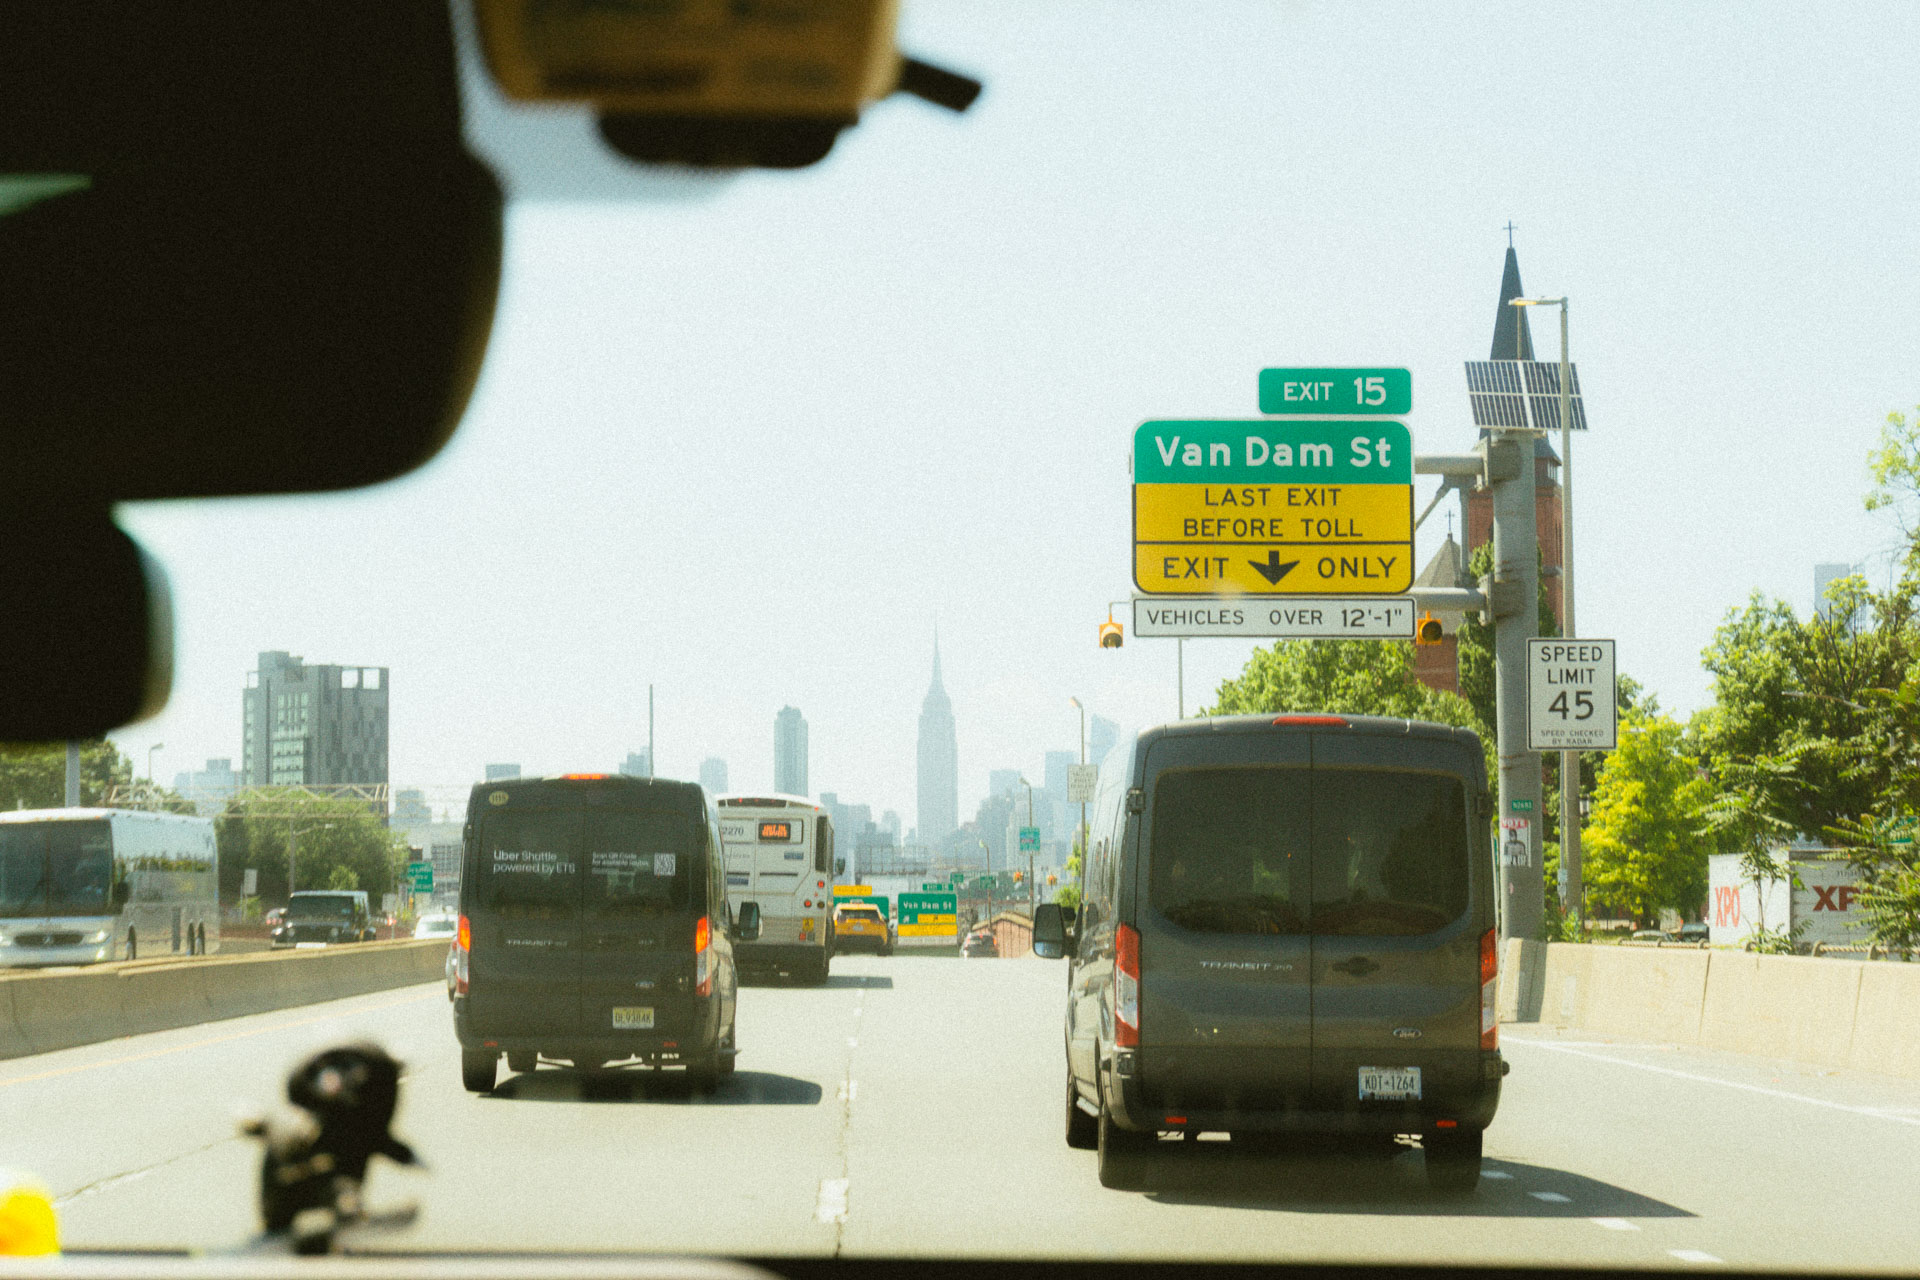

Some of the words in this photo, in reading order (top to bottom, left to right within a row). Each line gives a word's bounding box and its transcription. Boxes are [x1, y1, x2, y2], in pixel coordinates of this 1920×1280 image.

[1283, 381, 1334, 402] EXIT
[1353, 376, 1387, 406] 15
[1155, 435, 1231, 467] Van
[1245, 436, 1334, 468] Dam
[1350, 436, 1391, 468] St
[1204, 487, 1271, 507] LAST
[1287, 487, 1342, 507] EXIT
[1183, 518, 1284, 538] BEFORE
[1300, 518, 1363, 538] TOLL
[1163, 556, 1229, 579] EXIT
[1317, 556, 1396, 579] ONLY
[1147, 609, 1245, 627] VEHICLES
[1269, 609, 1323, 627] OVER
[1341, 608, 1403, 629] 12'-1"
[1541, 646, 1603, 662] SPEED
[1547, 668, 1595, 684] LIMIT
[1548, 690, 1594, 720] 45
[1541, 729, 1565, 737] SPEED
[1569, 729, 1604, 737] CHECKED
[493, 850, 520, 861] Uber
[522, 850, 557, 861] Shuttle
[493, 862, 540, 875] powered
[541, 862, 554, 875] by
[903, 900, 918, 909] Van
[921, 901, 939, 910] Dam
[942, 901, 951, 910] St
[1714, 885, 1740, 928] XPO
[1812, 885, 1868, 912] XP
[1200, 961, 1270, 971] TRANSIT
[1391, 1075, 1414, 1090] 1264
